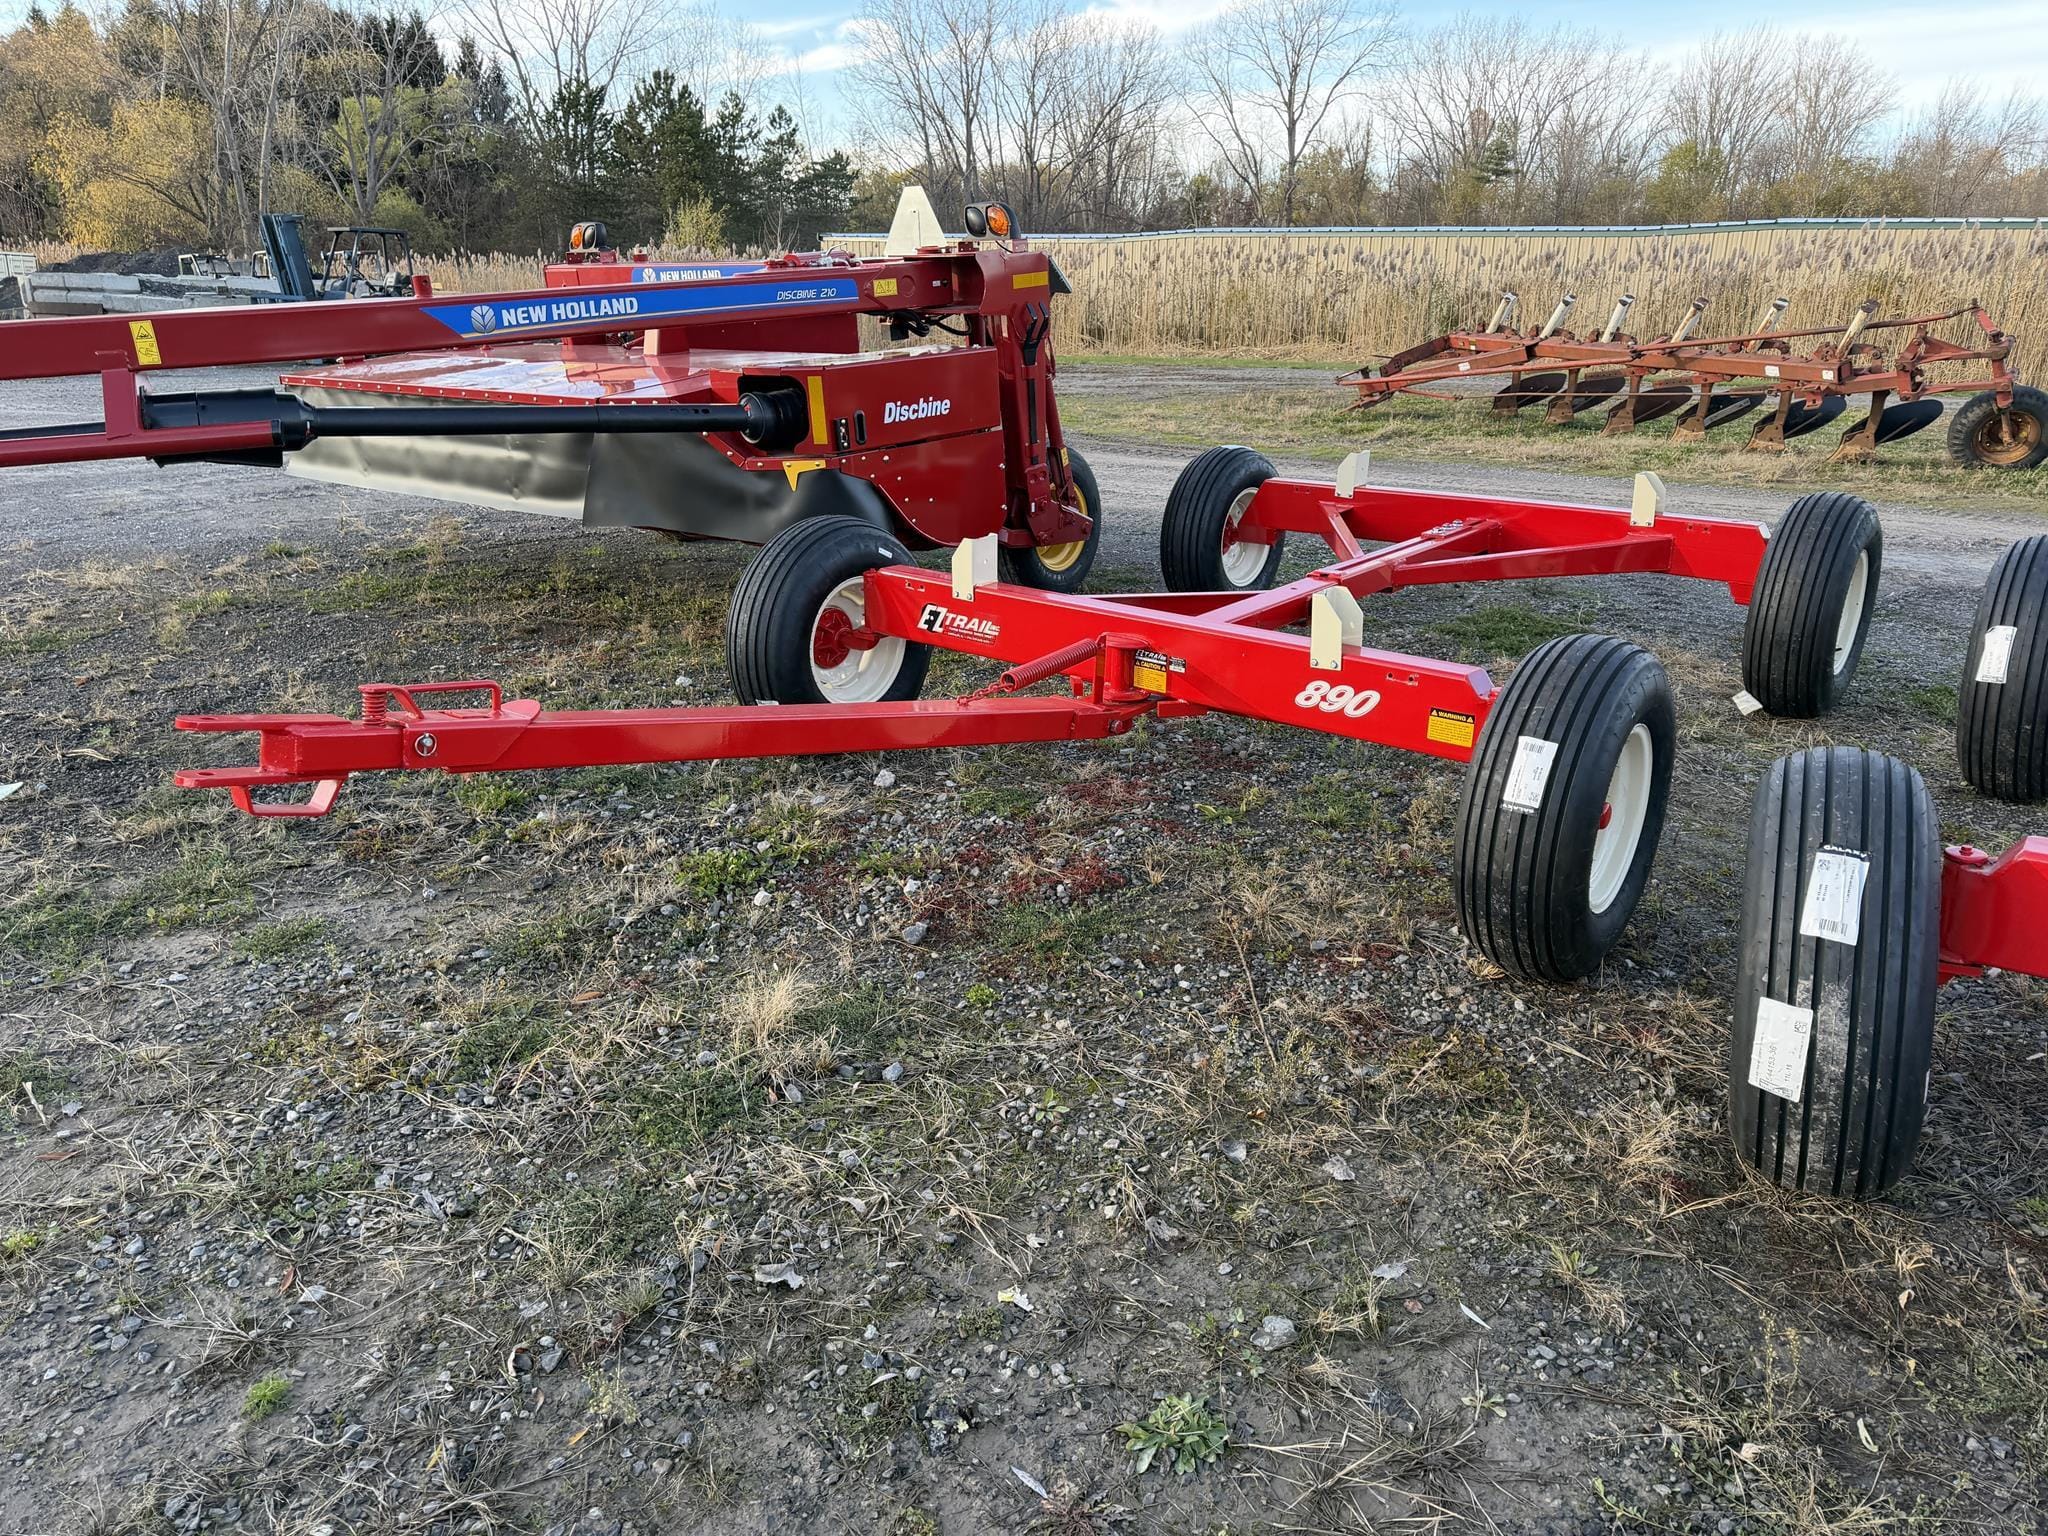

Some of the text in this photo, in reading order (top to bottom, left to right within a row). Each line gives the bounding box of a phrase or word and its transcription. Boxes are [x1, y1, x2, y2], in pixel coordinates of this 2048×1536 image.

[660, 269, 721, 282] NEW HOLLAND
[777, 287, 837, 301] DISCBINE 210
[501, 297, 639, 327] NEW HOLLAND
[883, 396, 951, 424] Discbine
[944, 612, 1000, 637] TRAIL
[1140, 660, 1162, 670] CAUTION
[1294, 680, 1381, 718] 890
[1438, 711, 1467, 722] WARNING
[1823, 844, 1868, 858] GALAXY
